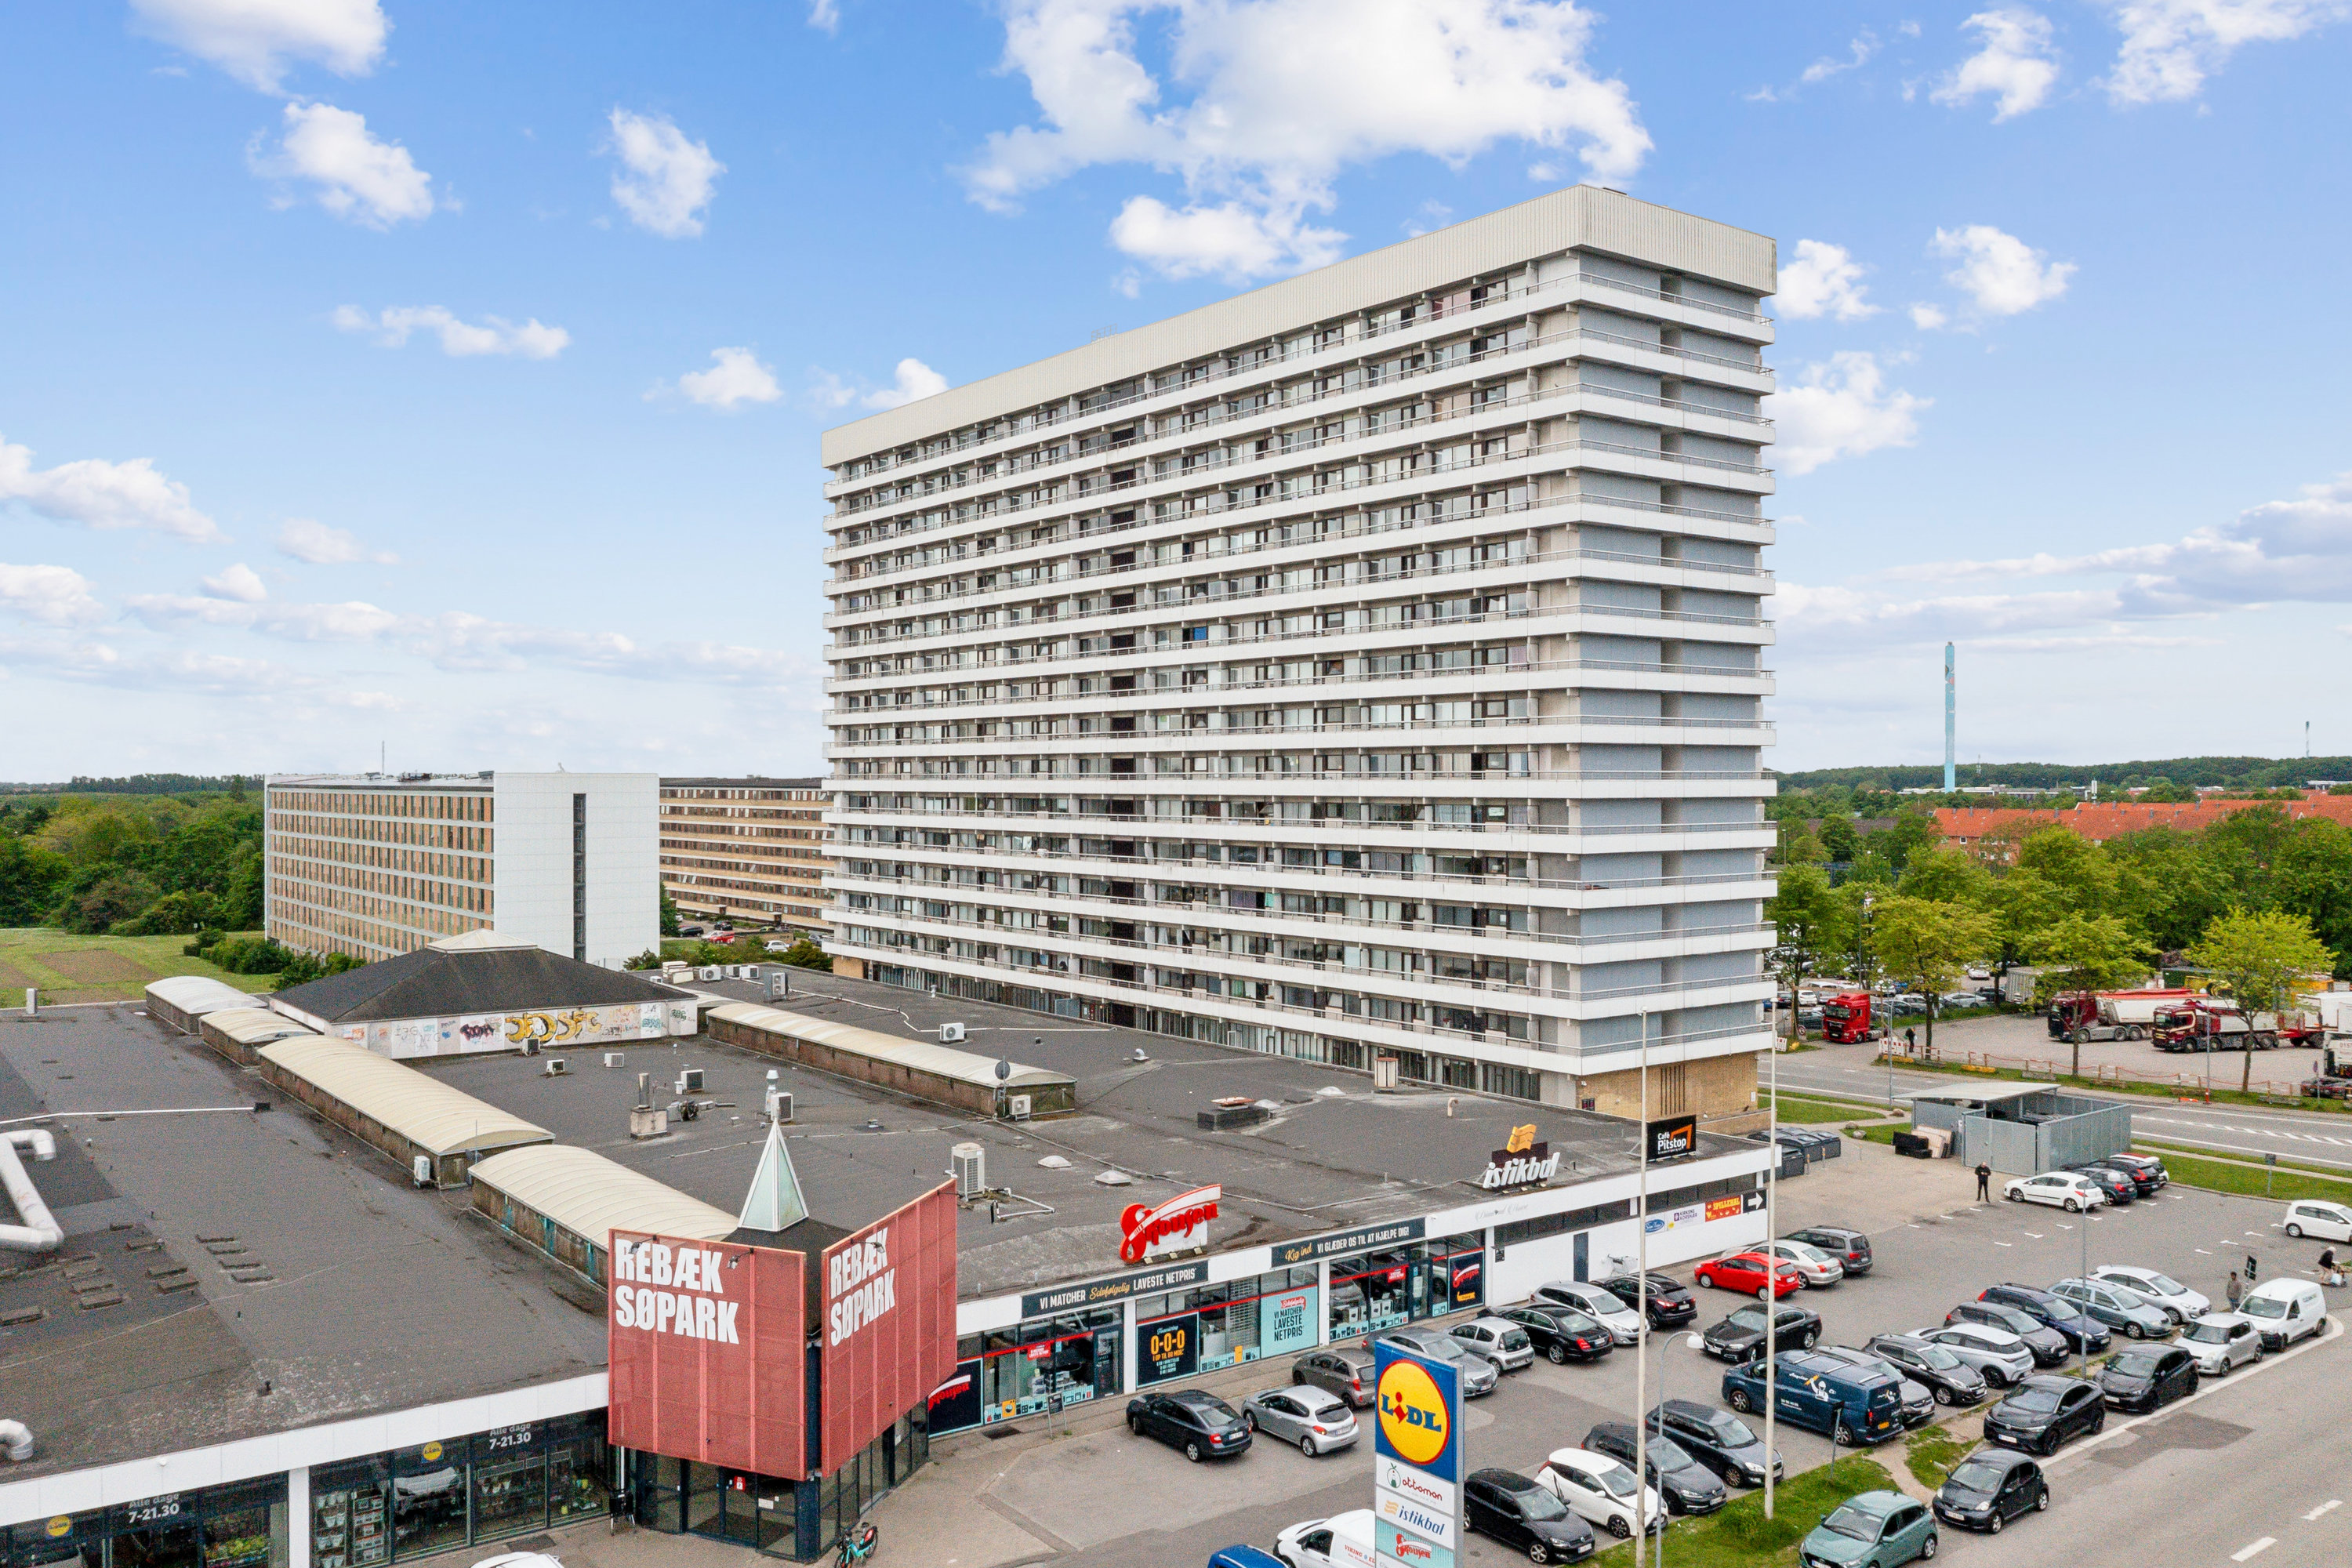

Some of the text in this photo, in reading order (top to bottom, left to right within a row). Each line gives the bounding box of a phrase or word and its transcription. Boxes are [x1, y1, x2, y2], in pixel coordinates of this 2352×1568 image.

[1657, 1131, 1670, 1140] Café
[1657, 1138, 1686, 1151] Pitstop
[1483, 1152, 1560, 1189] istikbal
[1713, 1197, 1740, 1210] SPILLEHAL
[1120, 1203, 1219, 1264] Skousen
[1285, 1250, 1300, 1261] Kig
[1301, 1243, 1312, 1257] ind
[1317, 1243, 1324, 1253] VI
[1325, 1239, 1347, 1253] GLÆDER
[1348, 1237, 1356, 1247] OS
[1367, 1233, 1374, 1243] AT
[1375, 1229, 1397, 1242] HJÆLPE
[1398, 1226, 1410, 1237] DIG!
[615, 1238, 724, 1294] REBÆK
[830, 1227, 888, 1299] REBÆK
[1040, 1296, 1048, 1309] VI
[1050, 1290, 1086, 1308] MATCHER
[1134, 1276, 1163, 1291] LAVESTE
[615, 1285, 739, 1345] SØPARK
[830, 1267, 895, 1347] SØPARK
[1280, 1306, 1302, 1317] MATCHER
[1274, 1314, 1302, 1330] LAVESTE
[1151, 1330, 1185, 1355] 0-0-0
[489, 1432, 532, 1450] 7-21.30
[490, 1423, 532, 1436] Alle dage
[129, 1493, 180, 1509] Alle dage
[1402, 1476, 1443, 1501] ottoman
[129, 1503, 180, 1524] 7-21.30
[1399, 1505, 1445, 1535] istikbal
[1345, 1544, 1363, 1557] VIKING
